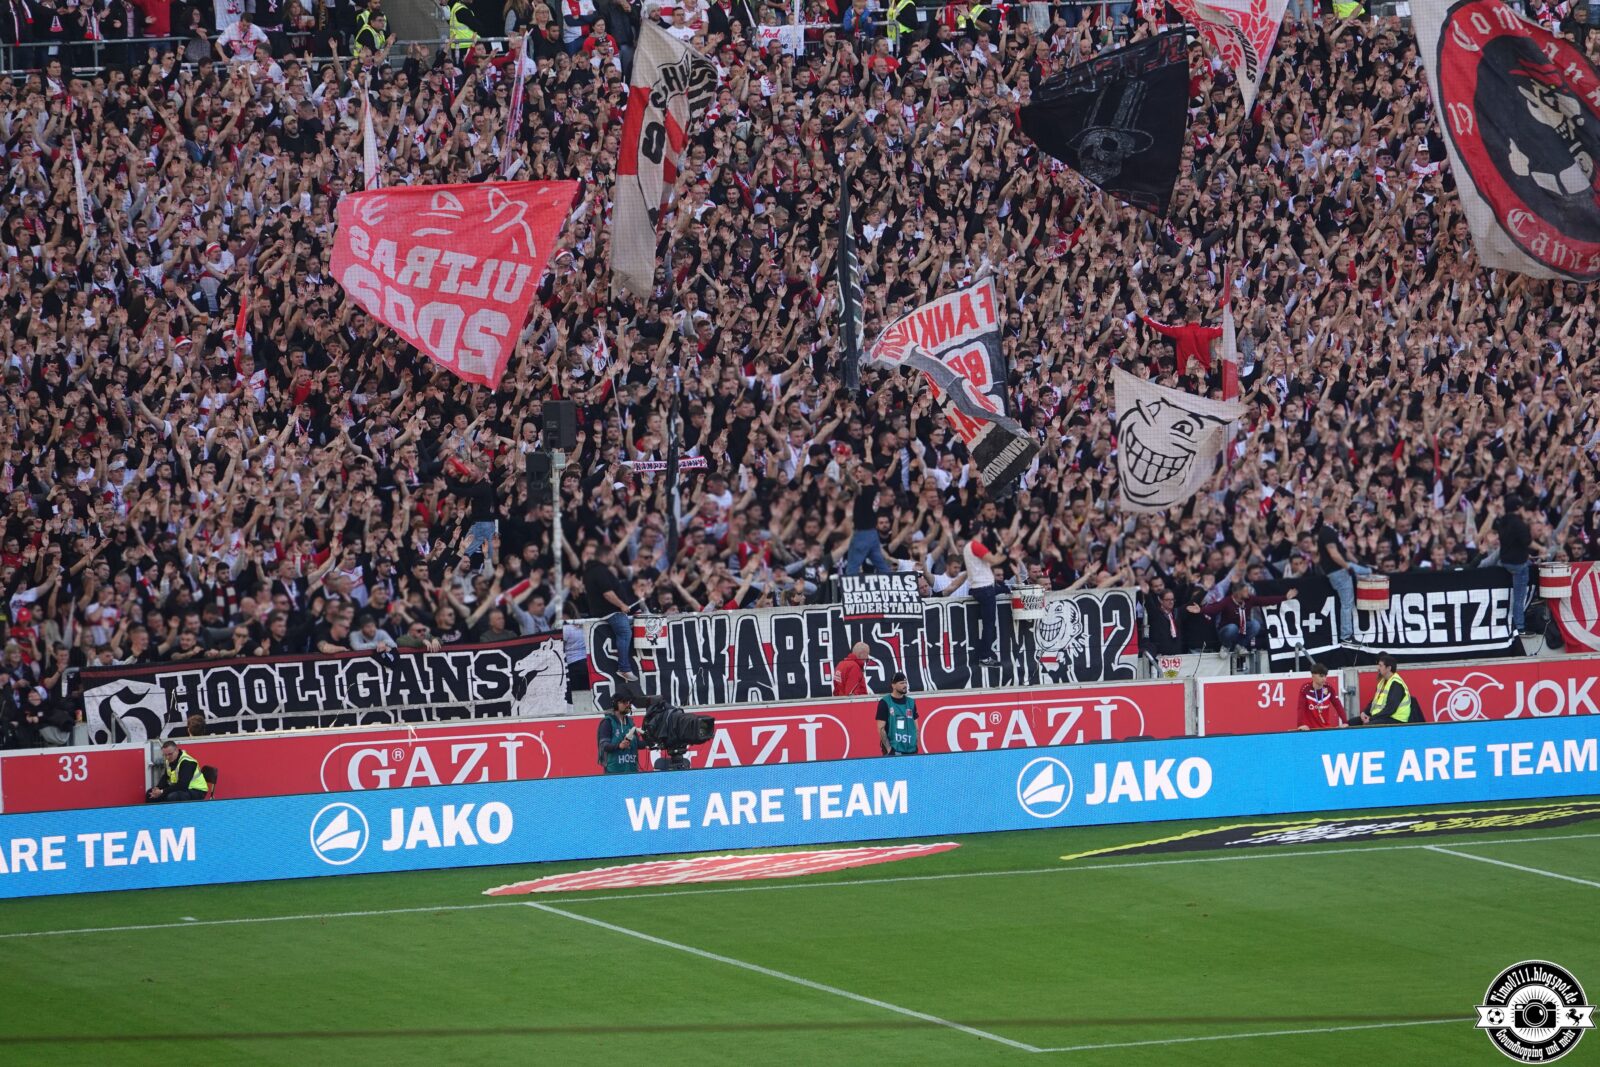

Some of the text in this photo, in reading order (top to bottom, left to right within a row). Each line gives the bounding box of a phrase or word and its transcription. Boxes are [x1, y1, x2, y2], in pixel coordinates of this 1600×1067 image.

[840, 574, 918, 592] ULTRAS
[844, 590, 920, 604] BEDEUTET
[844, 602, 922, 615] WIDERSTAND
[1264, 597, 1337, 650] 50+1
[155, 647, 512, 717] HOOLIGANS
[1257, 682, 1286, 708] 34
[58, 755, 89, 782] 33
[1085, 756, 1213, 805] JAKO
[1321, 739, 1598, 787] WE ARE TEAM
[382, 802, 514, 852] JAKO
[626, 780, 908, 832] WE ARE TEAM
[78, 826, 196, 868] TEAM
